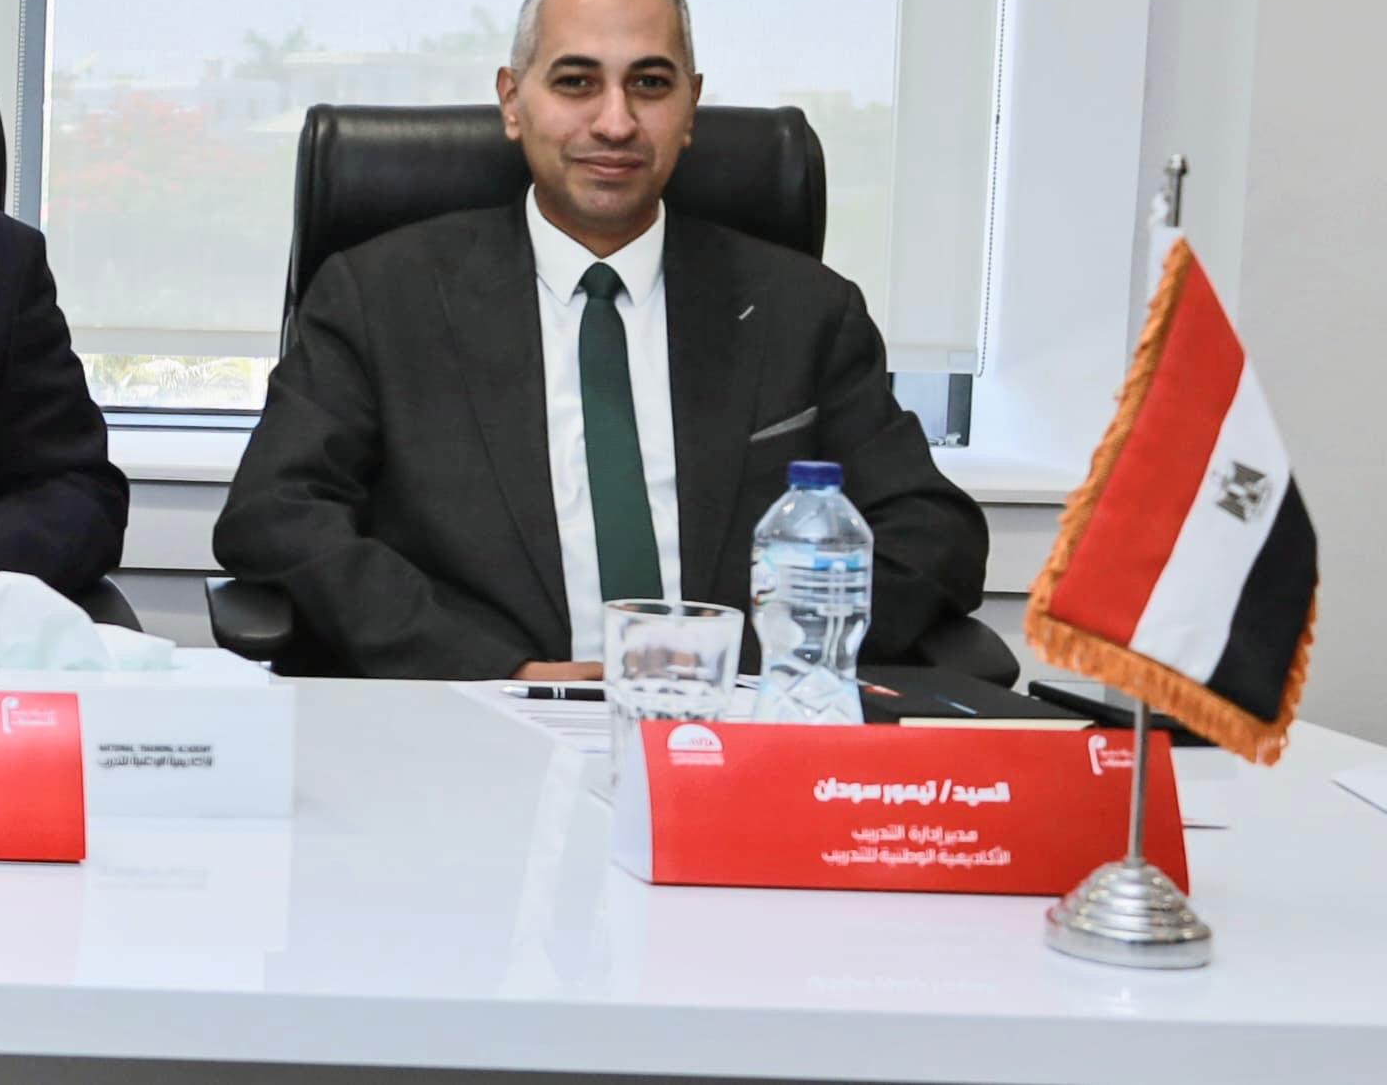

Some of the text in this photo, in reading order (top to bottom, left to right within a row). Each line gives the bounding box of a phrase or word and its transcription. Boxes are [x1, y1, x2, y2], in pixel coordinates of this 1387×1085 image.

[882, 779, 938, 805] تيمور
[952, 780, 1011, 807] السيد
[850, 824, 979, 845] مدير إدارة التدريب
[821, 845, 879, 867] للتدريب
[879, 846, 937, 867] الوطنية
